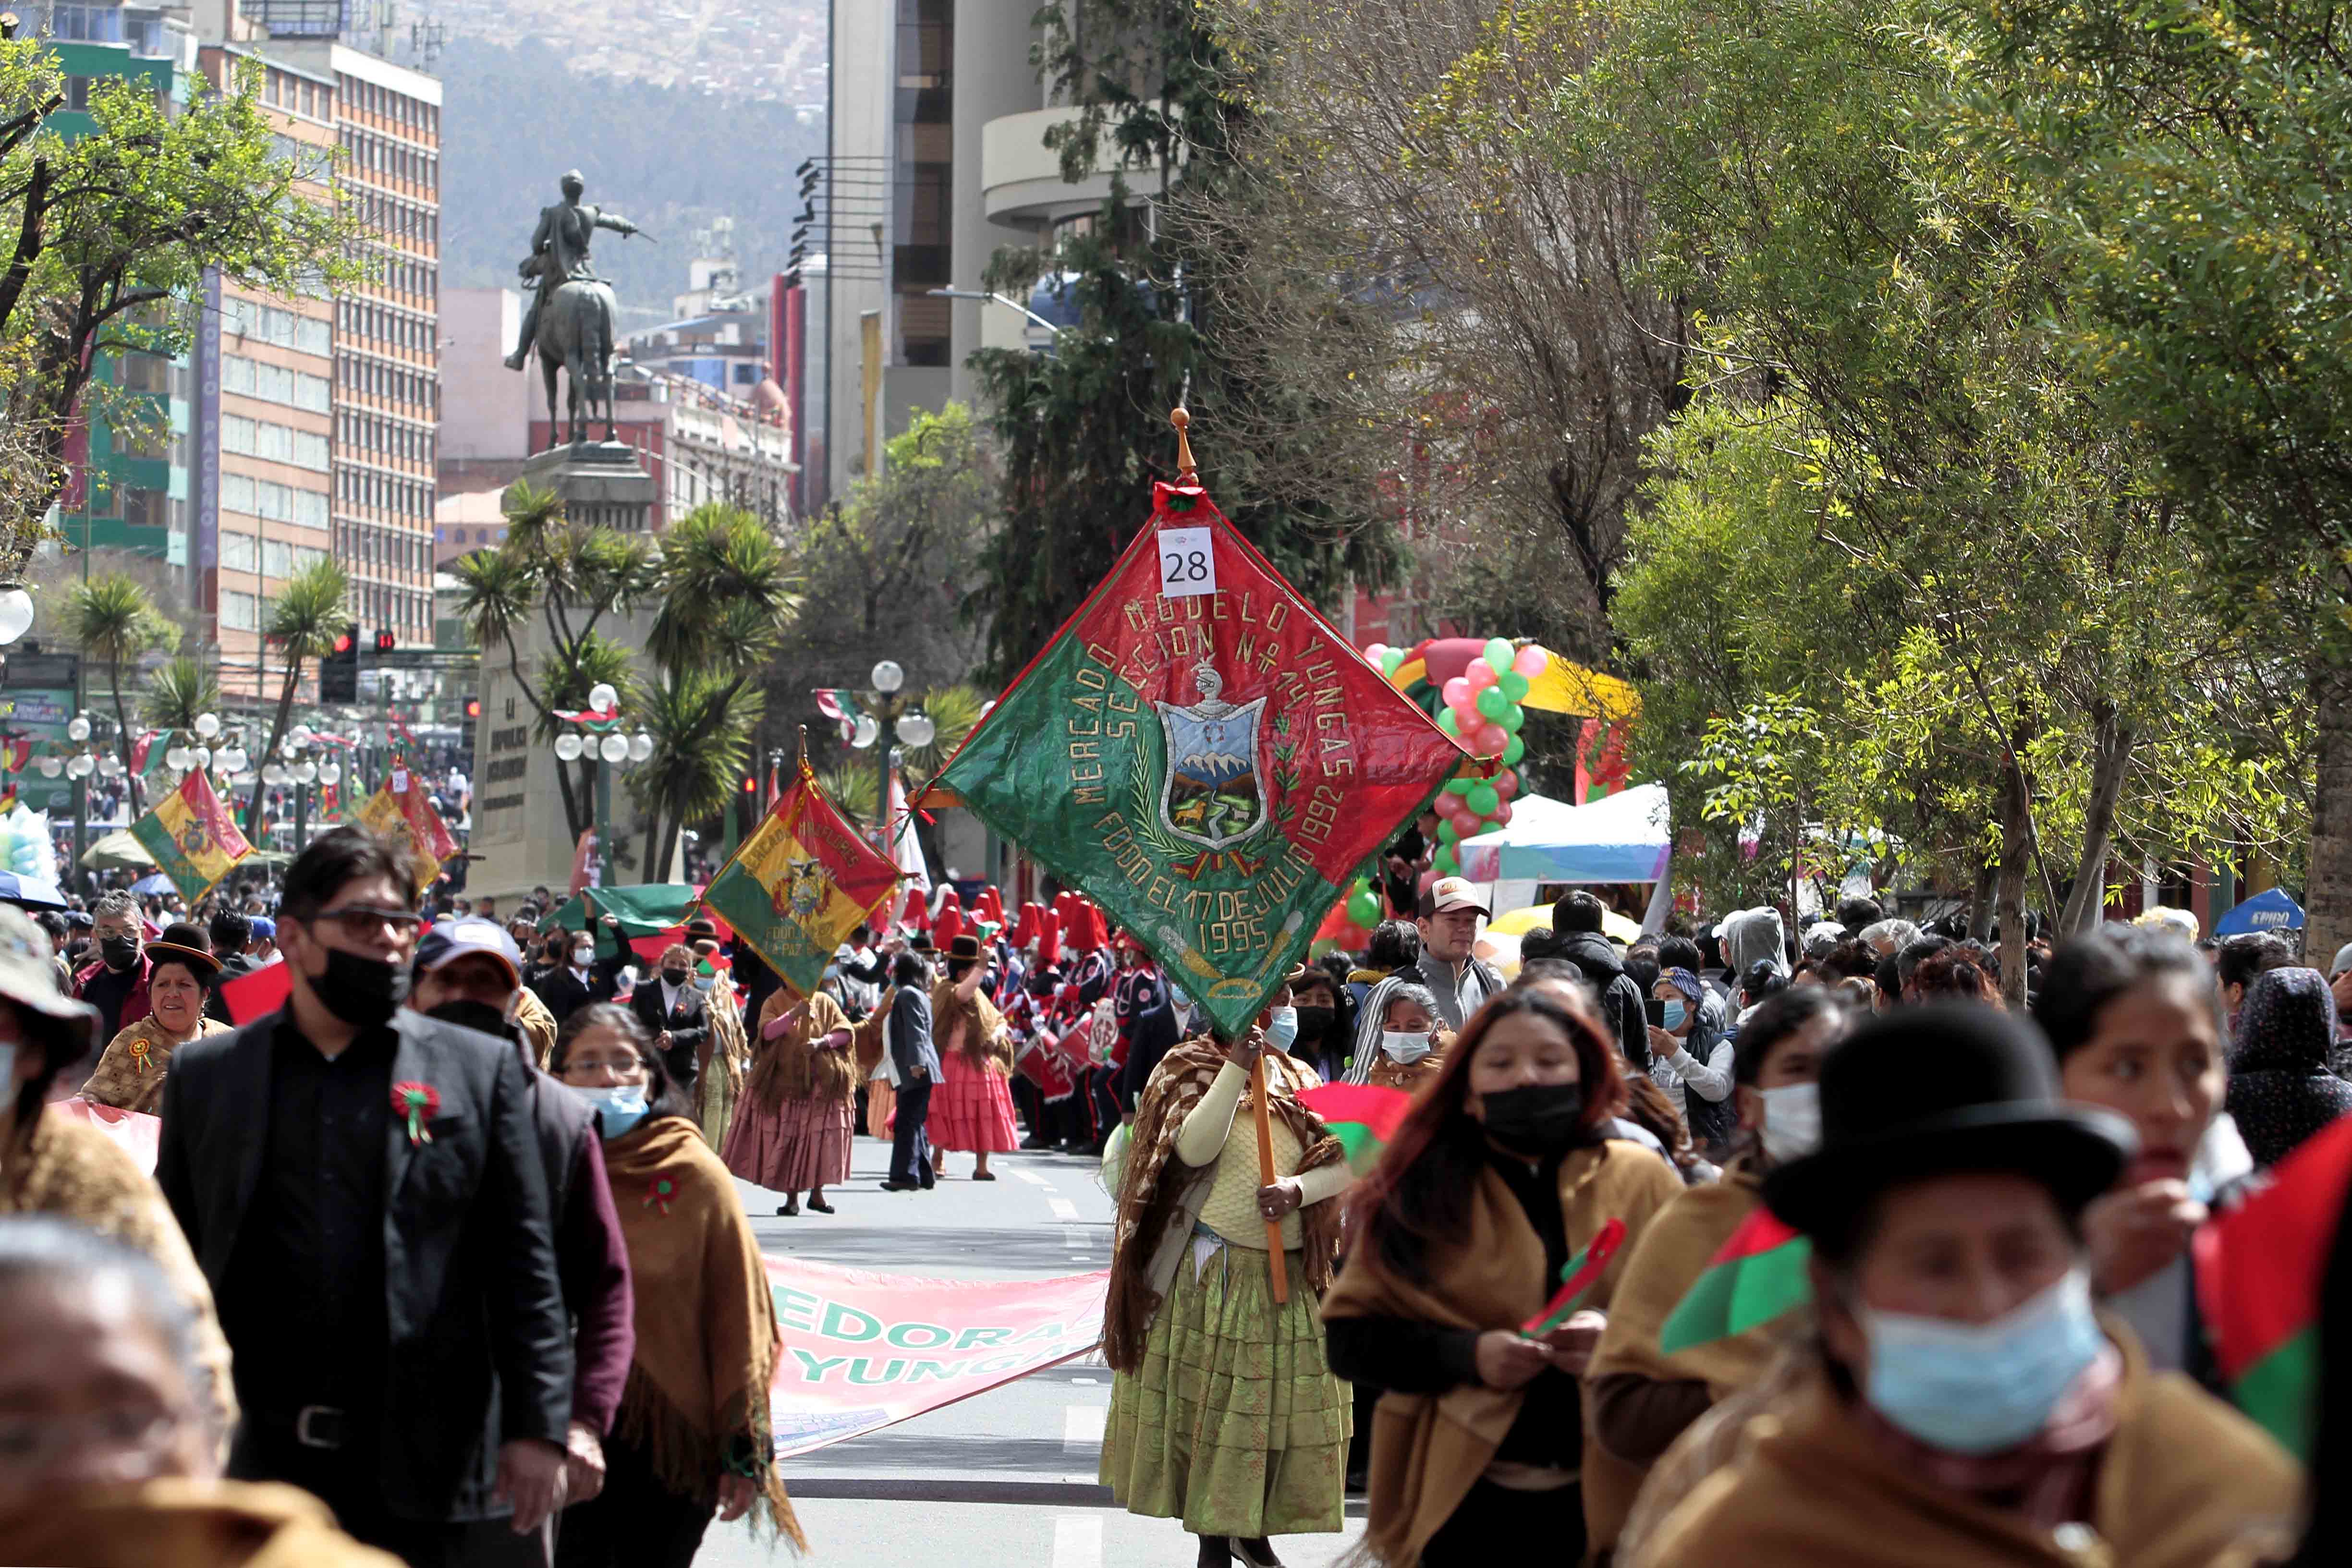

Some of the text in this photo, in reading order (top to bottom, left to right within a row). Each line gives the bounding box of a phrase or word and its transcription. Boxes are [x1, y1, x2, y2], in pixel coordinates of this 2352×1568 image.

[1165, 550, 1208, 583] 28
[1069, 589, 1353, 804] MERCADO MODELO YUNGAS
[1106, 623, 1214, 738] SECCION
[1275, 671, 1309, 710] 14
[1093, 784, 1344, 922] FDDO EL 17 DE JULIO 1992
[1199, 917, 1270, 954] 1995
[771, 1284, 1063, 1349] EDORA
[792, 1343, 1064, 1383] YUNGA
